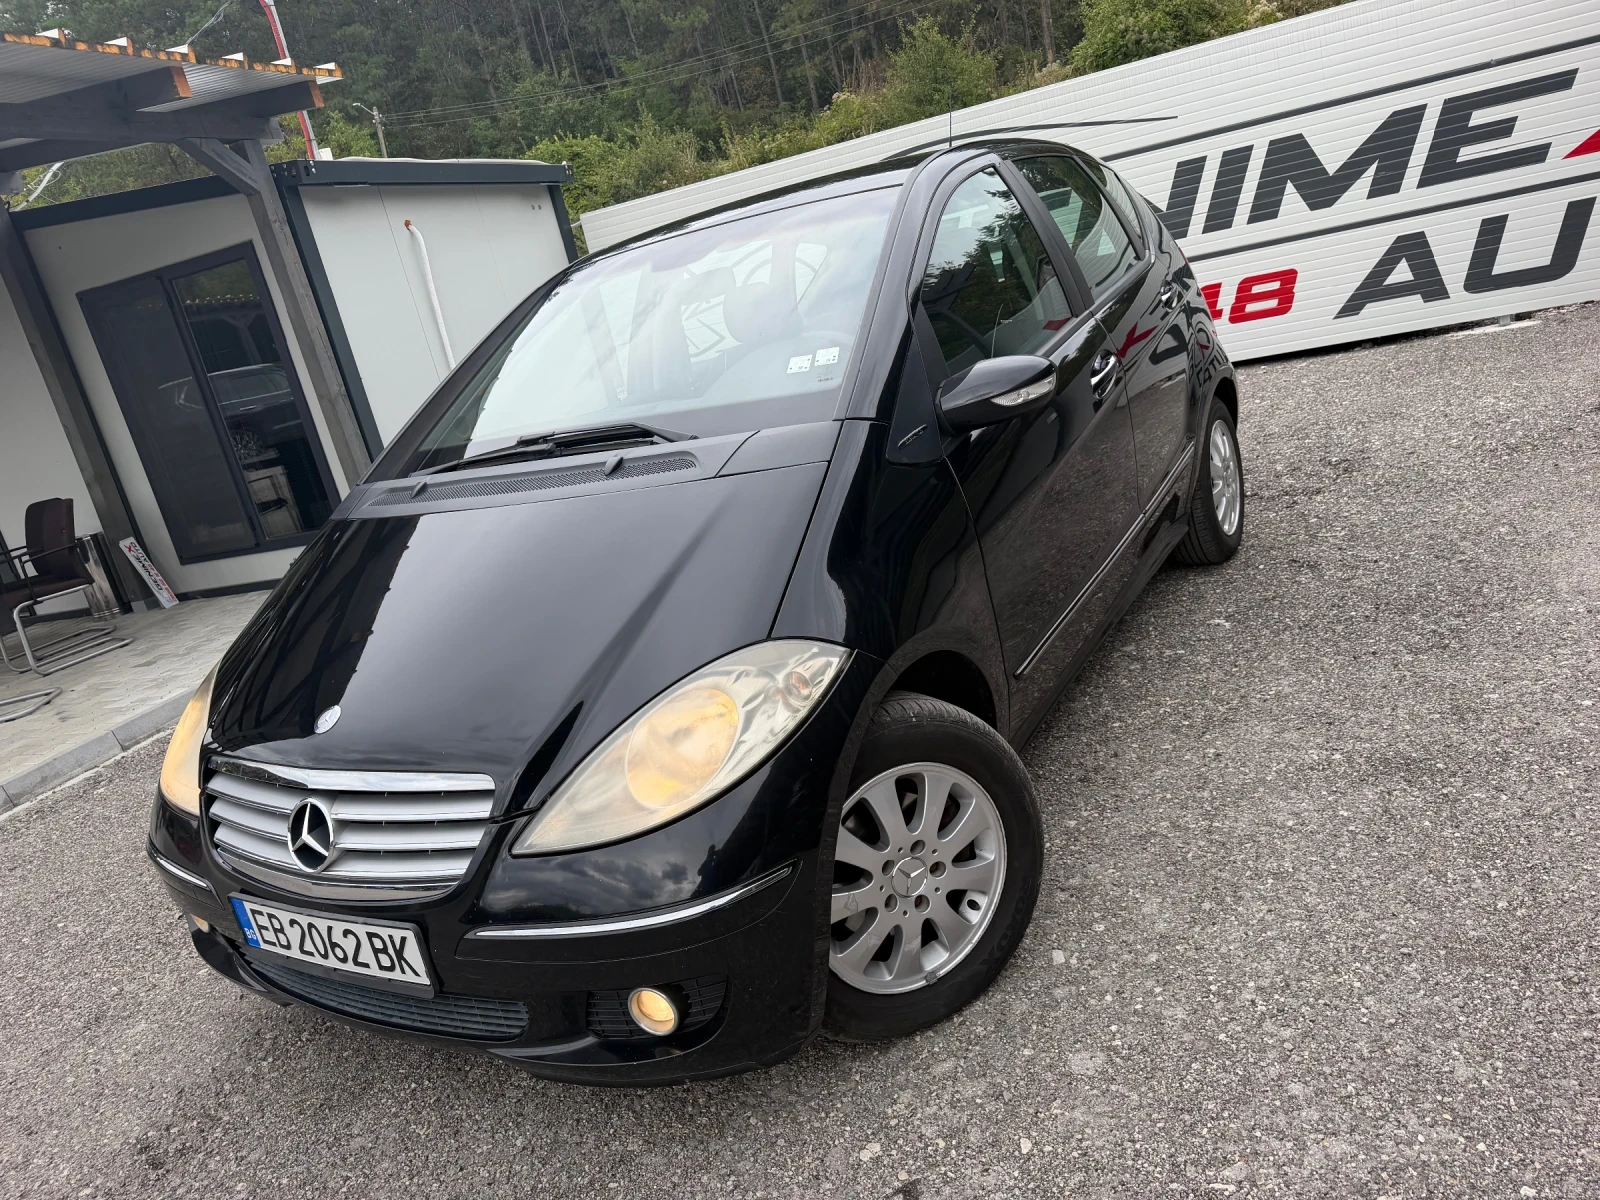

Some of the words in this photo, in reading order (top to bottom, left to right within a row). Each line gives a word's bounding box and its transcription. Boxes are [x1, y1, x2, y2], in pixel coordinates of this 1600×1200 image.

[1139, 67, 1600, 240] IME
[124, 544, 164, 591] GENIMEX
[130, 541, 150, 564] AUTO
[244, 927, 257, 940] BG
[249, 907, 421, 977] EB2062BK
